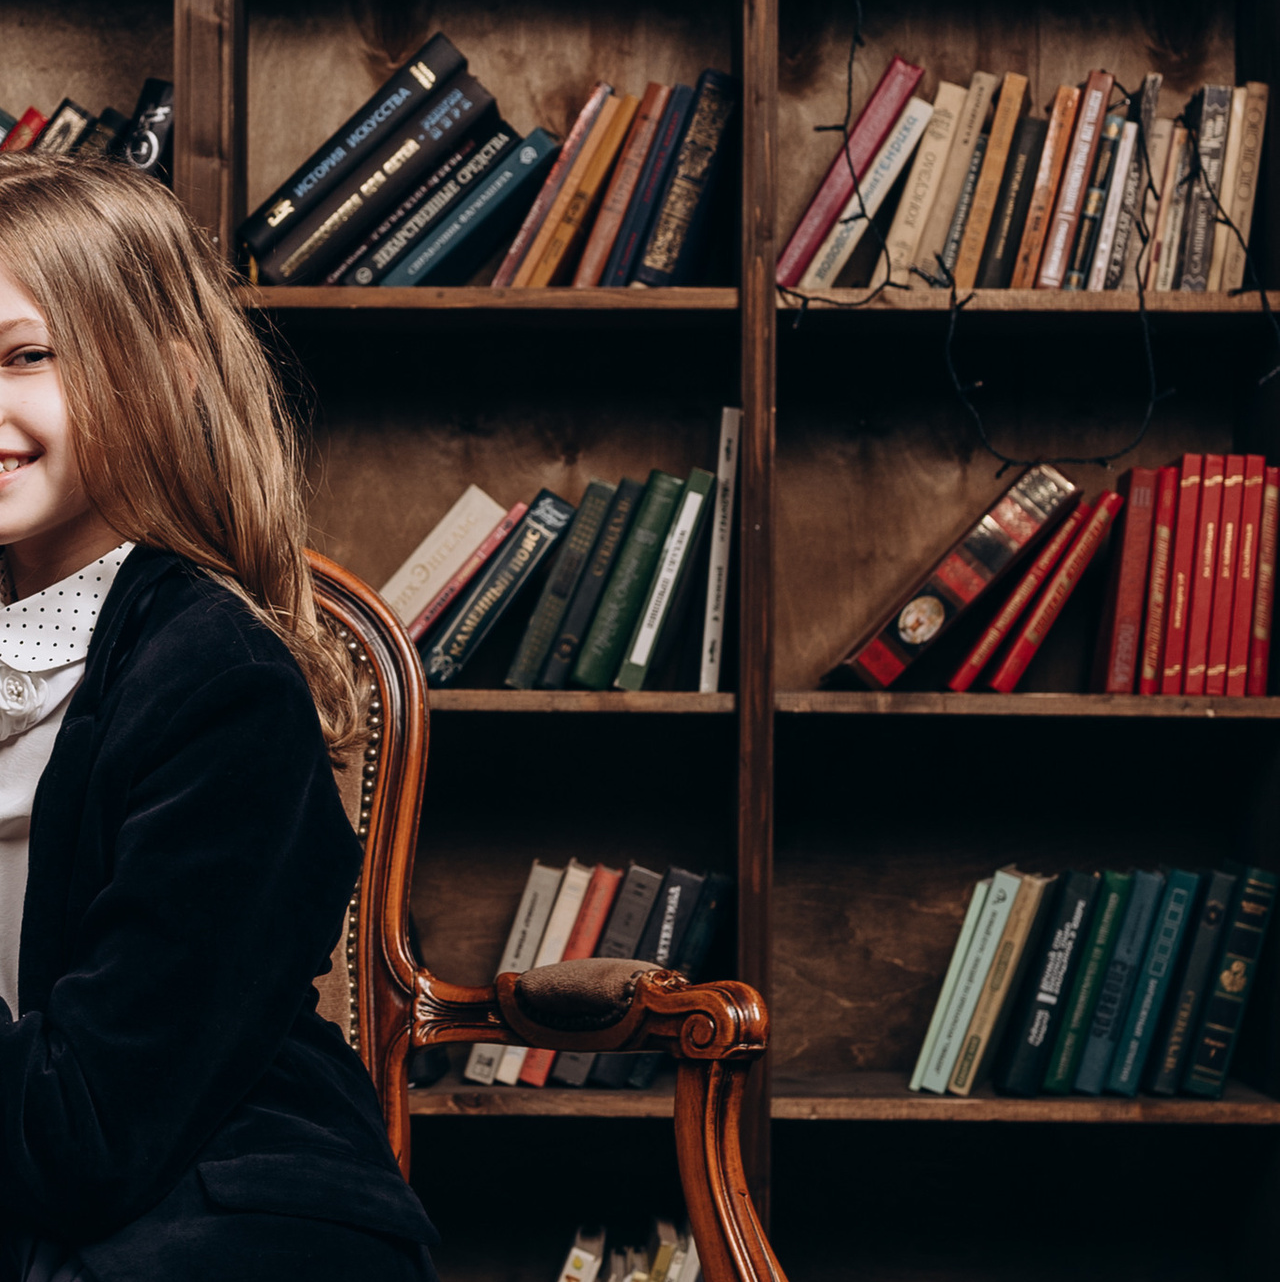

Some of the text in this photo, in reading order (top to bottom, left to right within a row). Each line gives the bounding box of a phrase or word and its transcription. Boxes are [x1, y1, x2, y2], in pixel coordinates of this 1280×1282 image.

[291, 82, 413, 201] ИСТОРИЯ ИСКУССТВА
[358, 168, 388, 199] ДЛЯ
[380, 135, 421, 177] ДЕТЕЙ
[369, 177, 462, 270] ЛЕКАРСТВЕННЫЕ
[453, 129, 511, 186] СРЕДСТВА
[901, 149, 938, 227] КОНСУЭЛО
[405, 220, 462, 277] СПРАВОЧНИК
[408, 507, 481, 588] ЭНГЕЛЬС
[445, 526, 543, 659] КАМЕННЫЙ ПОЯС
[1115, 624, 1133, 683] ПОБЕДА
[1088, 959, 1132, 1041] СЛОВАРЬ
[1117, 978, 1159, 1082] ЗАРУБЕЖНЫЙ ДЕТЕКТИВ
